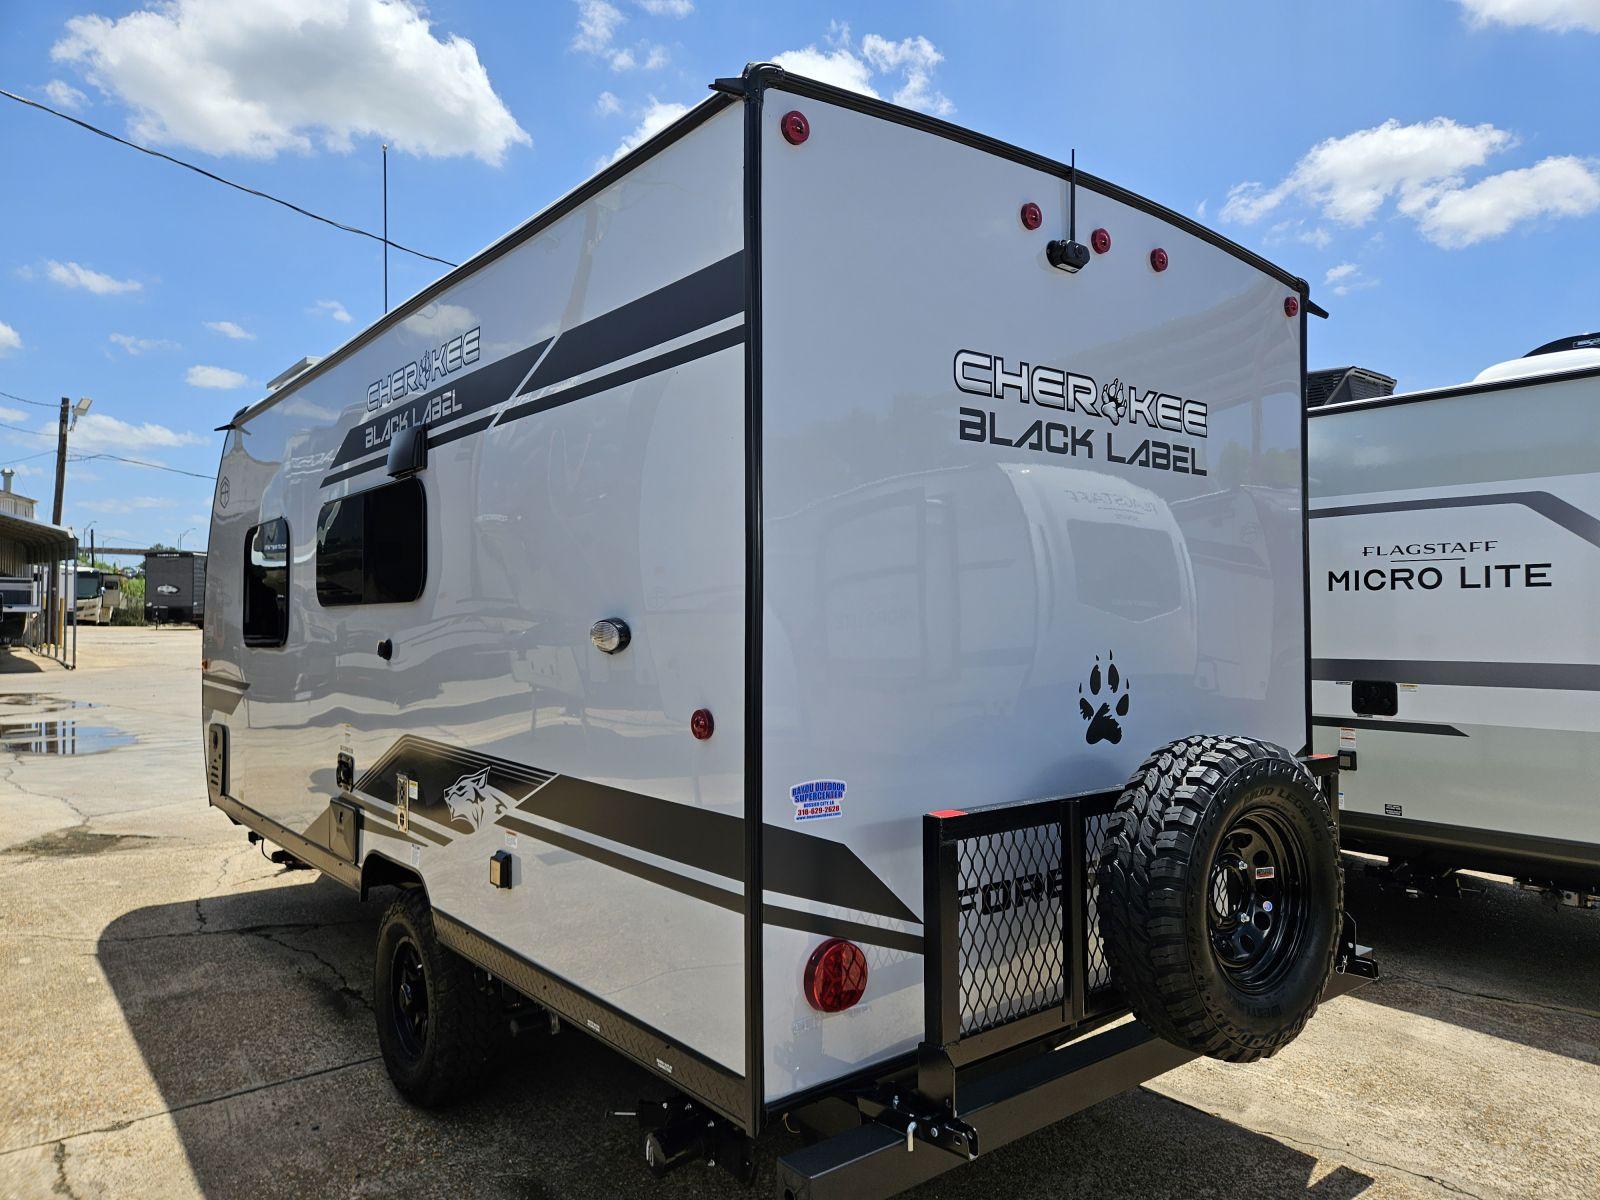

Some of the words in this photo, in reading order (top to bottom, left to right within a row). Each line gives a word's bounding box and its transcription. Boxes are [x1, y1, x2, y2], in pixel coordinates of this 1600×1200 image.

[365, 410, 408, 448] BLACK
[412, 388, 463, 427] LABEL
[959, 406, 1095, 459] BLACK
[1107, 432, 1208, 477] LABEL
[1362, 540, 1499, 557] FLAGSTAFF
[1328, 566, 1443, 591] MICRO
[1460, 563, 1552, 589] LITE
[815, 782, 845, 792] OUTDOOR
[794, 791, 842, 802] SUPERCENTER
[798, 805, 839, 816] 318-629-2628
